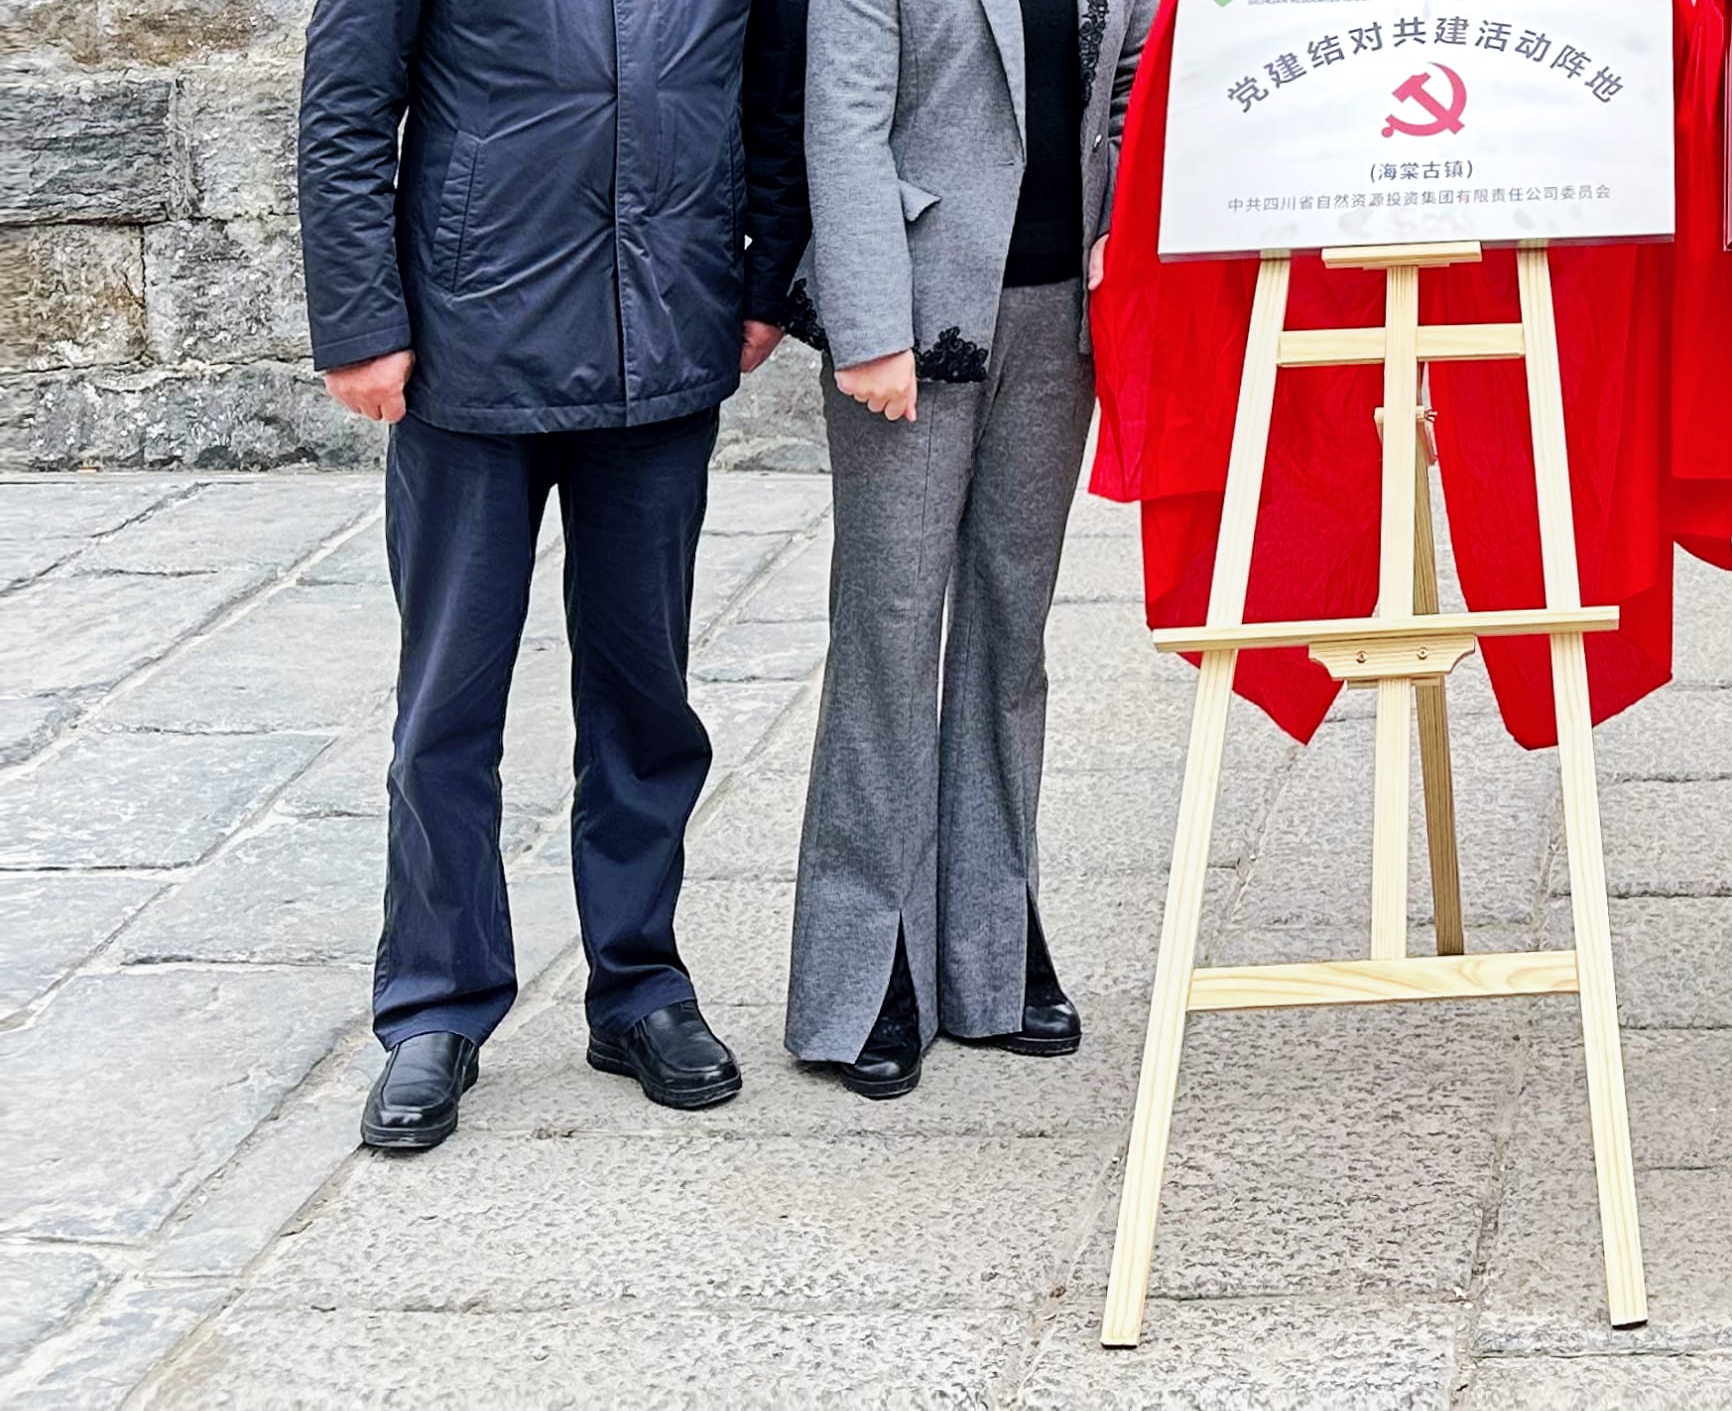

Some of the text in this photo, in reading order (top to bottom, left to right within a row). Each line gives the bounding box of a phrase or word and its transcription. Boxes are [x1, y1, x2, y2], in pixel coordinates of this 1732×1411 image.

[1227, 16, 1624, 113] 党建结对共建活动阵地
[1227, 184, 1612, 213] 中共四川省自然资源投资集团有限责任公司委员会
